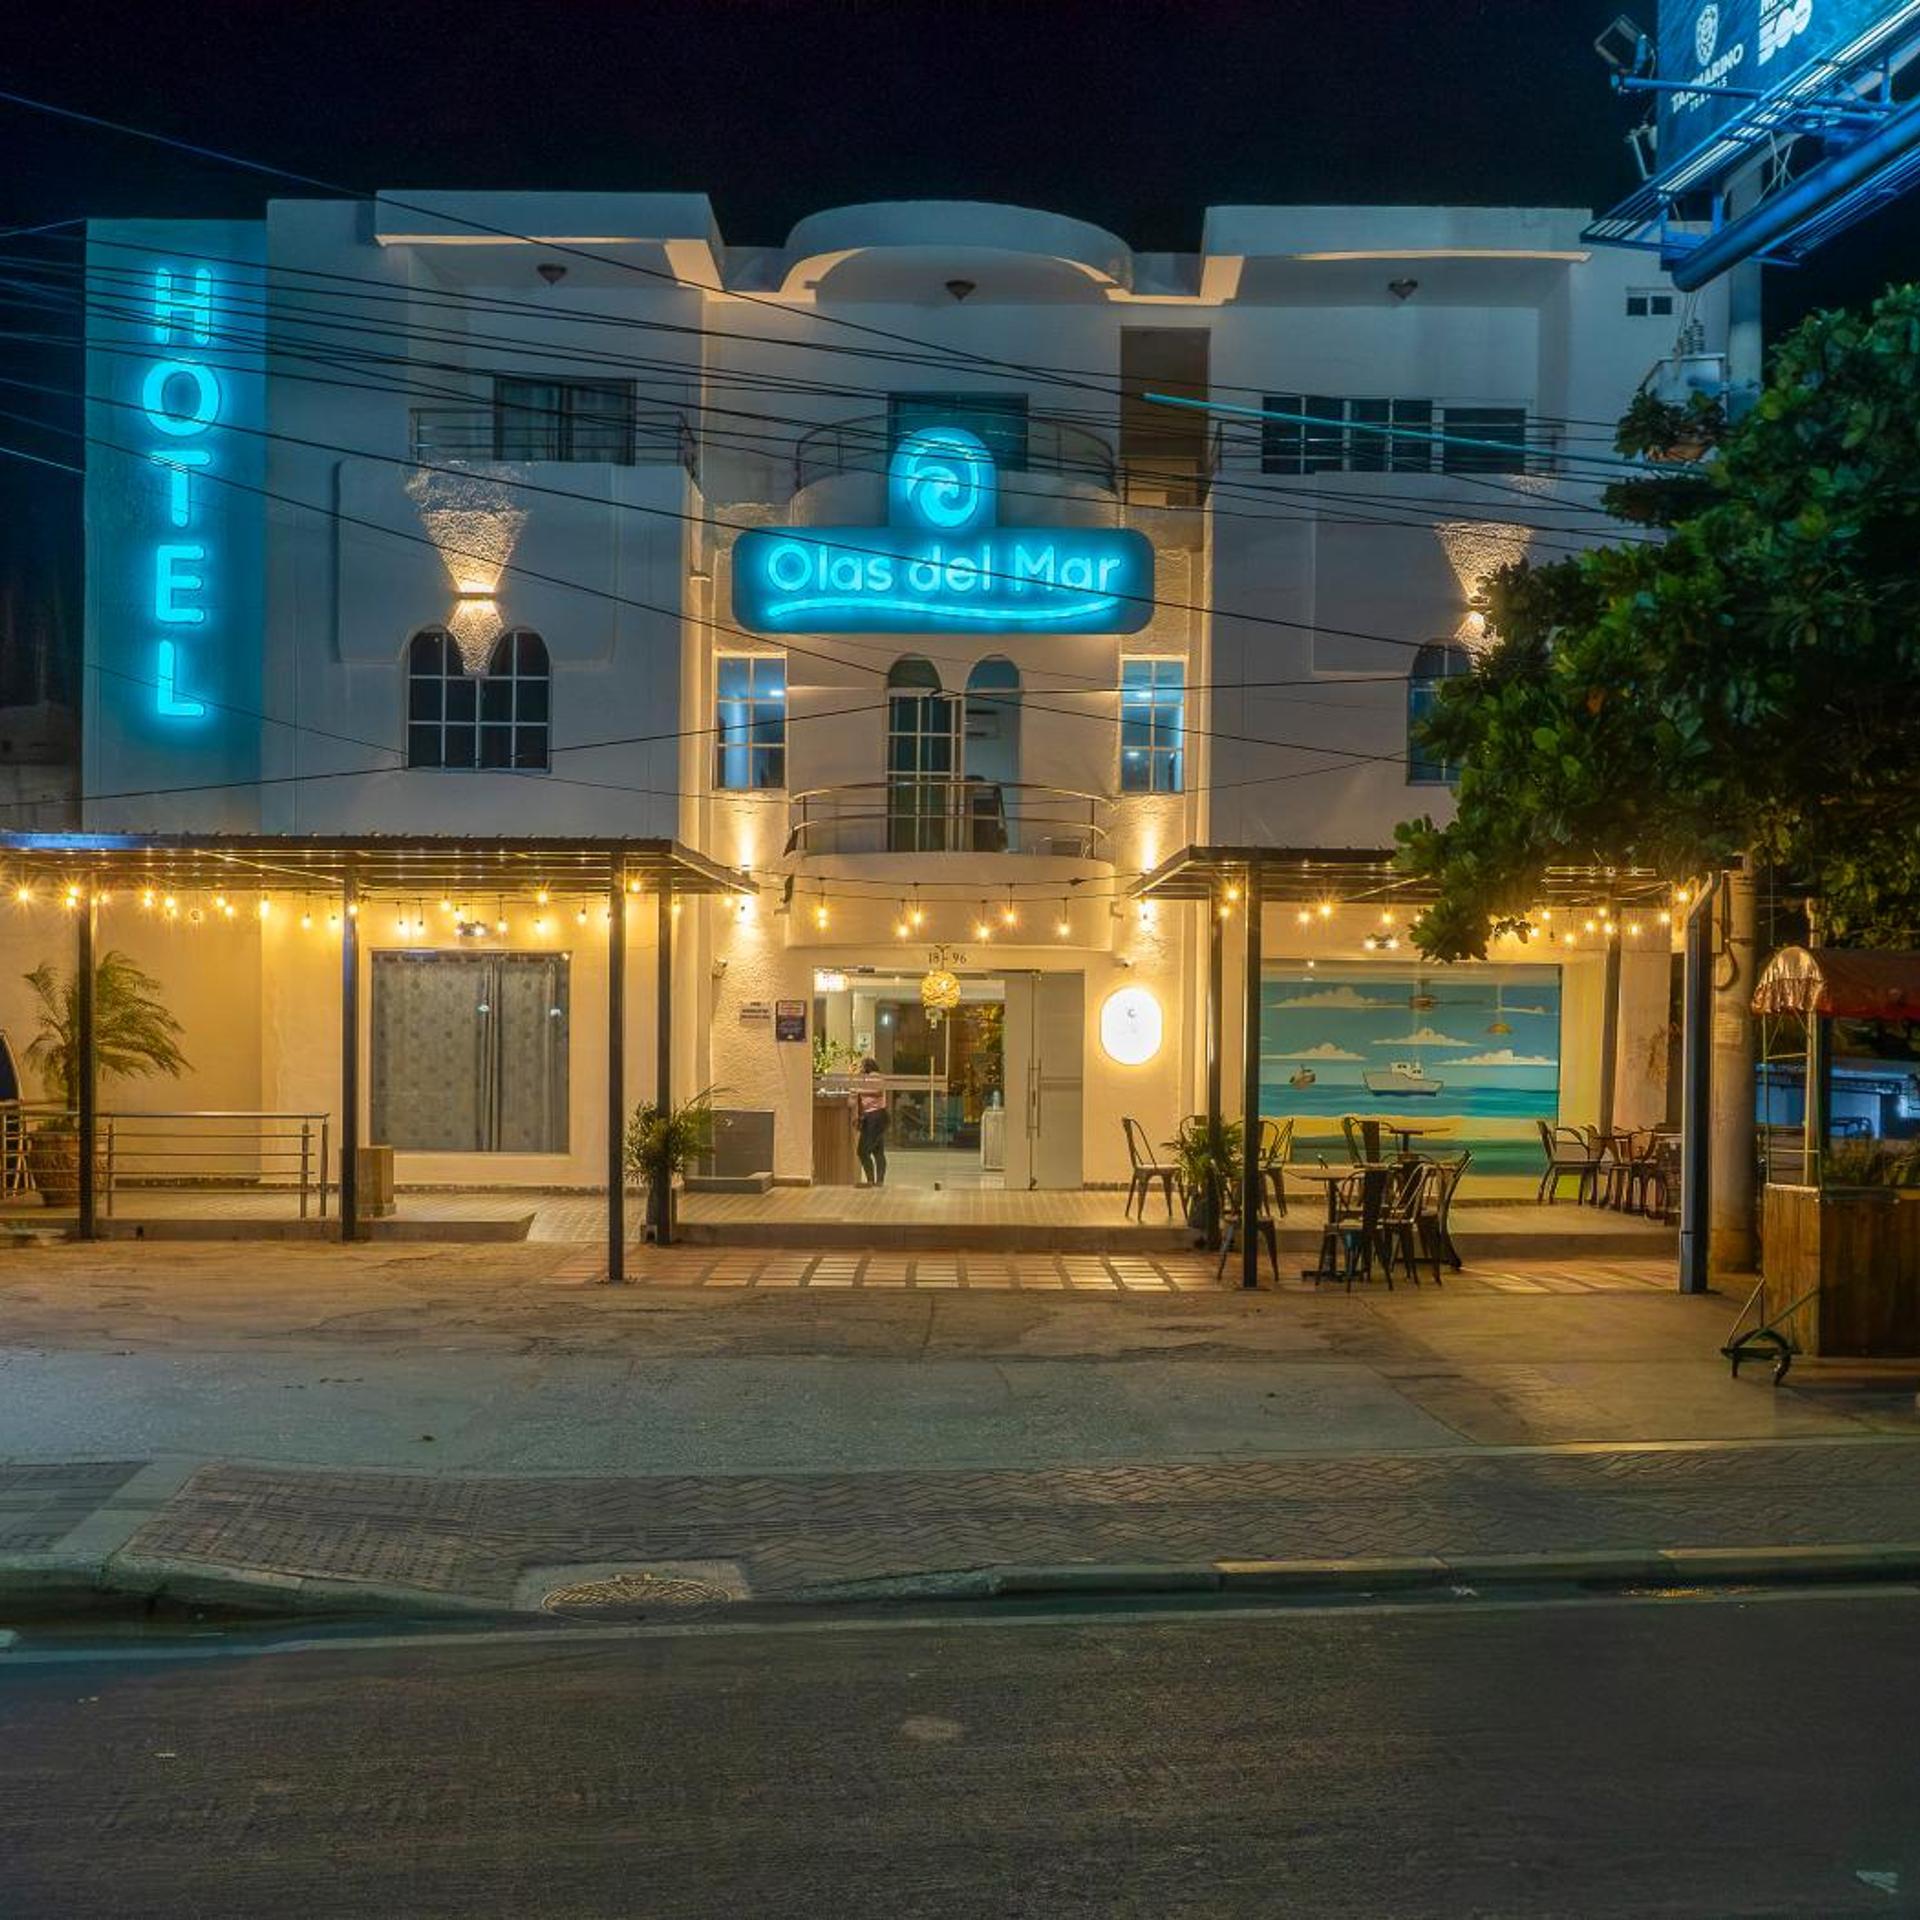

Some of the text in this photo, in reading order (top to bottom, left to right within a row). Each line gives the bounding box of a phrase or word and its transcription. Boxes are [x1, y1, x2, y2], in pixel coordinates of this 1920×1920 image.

[142, 267, 221, 717] HOTEL
[767, 543, 1120, 594] Olas del Mar
